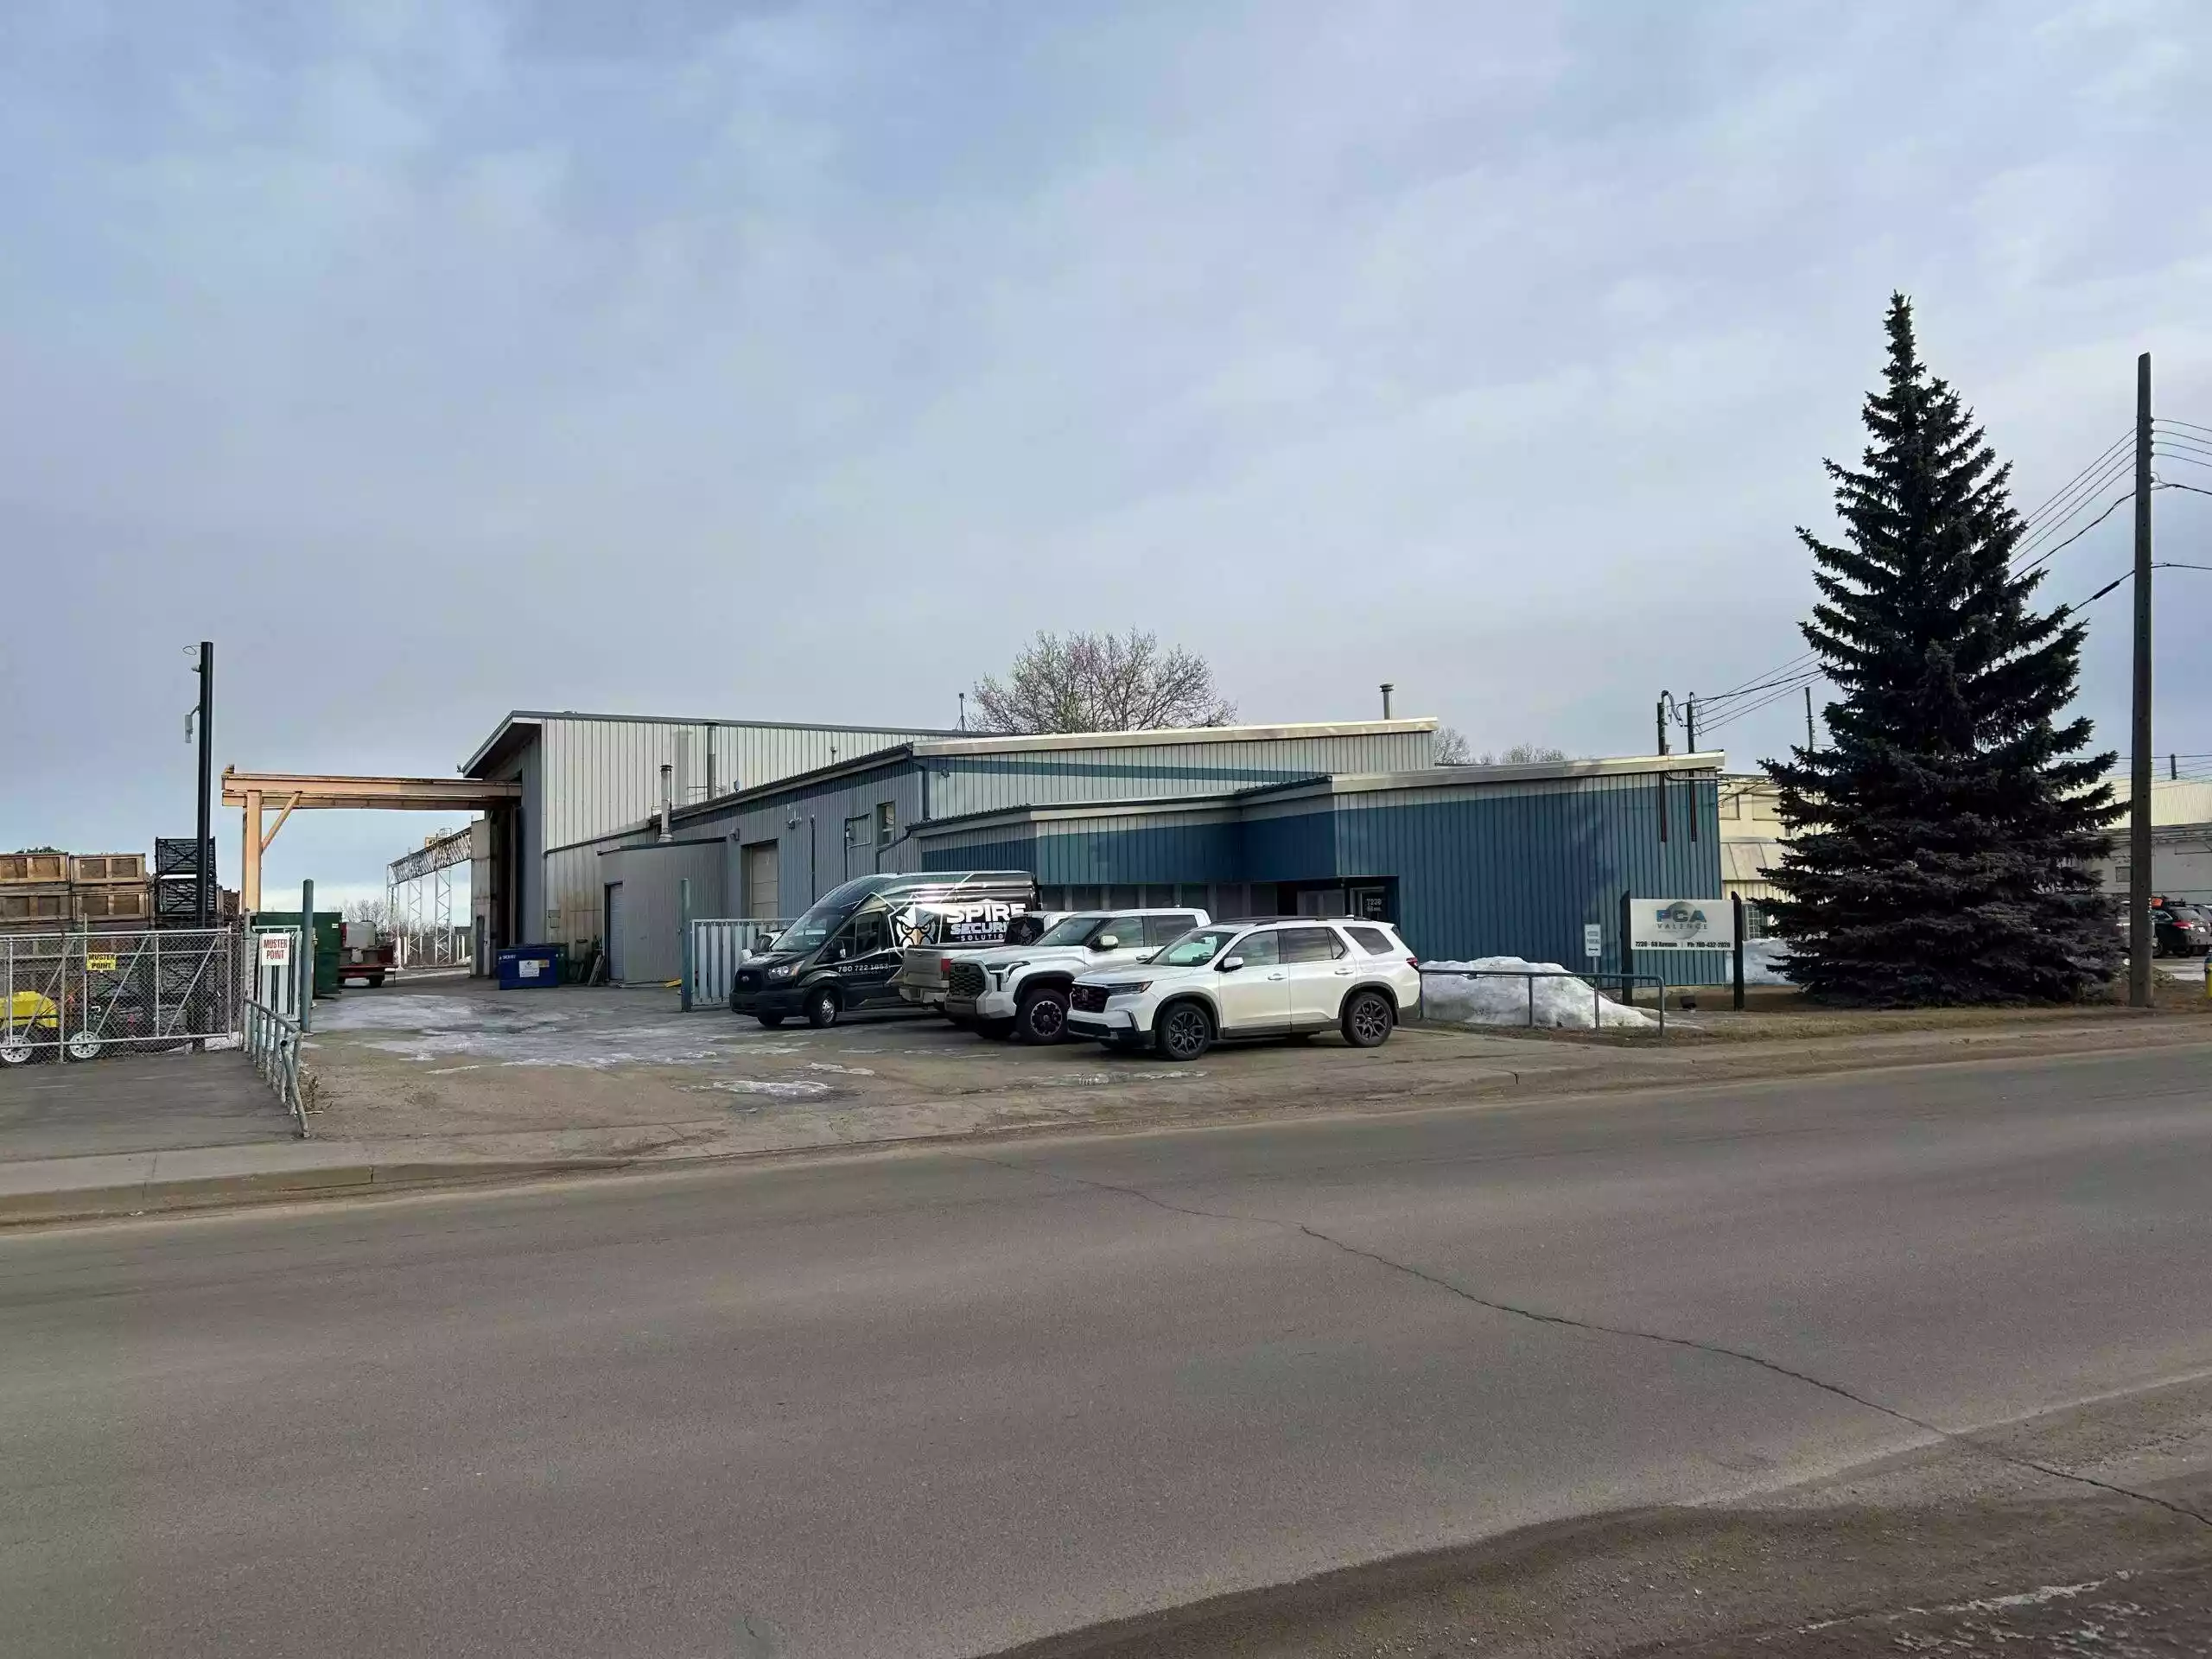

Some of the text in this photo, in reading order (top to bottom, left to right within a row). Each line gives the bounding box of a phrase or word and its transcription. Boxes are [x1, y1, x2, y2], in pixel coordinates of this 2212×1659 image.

[1656, 910, 1707, 922] PCA
[950, 922, 1009, 934] SECURI
[263, 938, 288, 949] MUSTER
[266, 950, 285, 959] POINT
